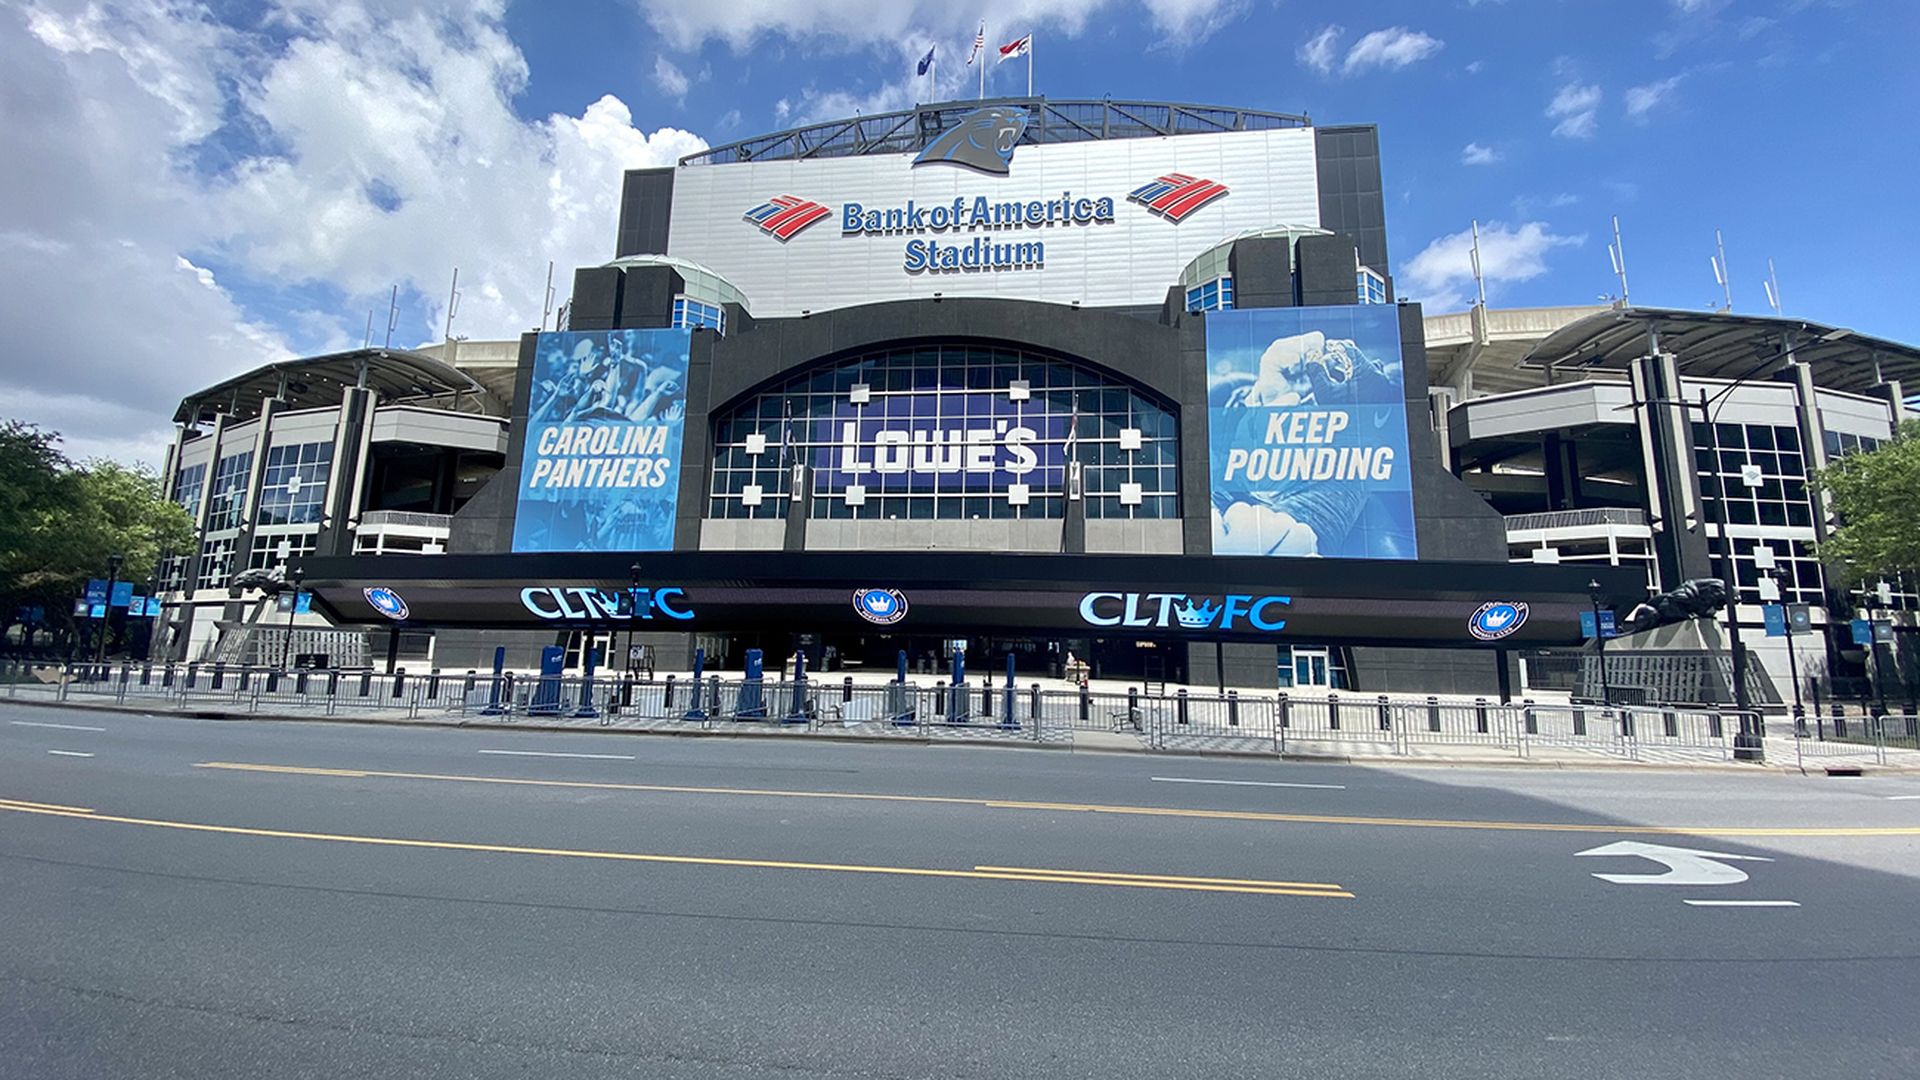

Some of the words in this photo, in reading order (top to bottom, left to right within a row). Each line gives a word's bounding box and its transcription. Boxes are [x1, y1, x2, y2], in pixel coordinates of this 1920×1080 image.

[842, 200, 925, 234] Bank
[929, 196, 965, 230] of
[969, 191, 1114, 227] America
[904, 236, 1045, 271] Stadium
[537, 425, 669, 456] CAROLINA
[1264, 411, 1349, 445] KEEP
[840, 419, 1038, 475] LOWE'S
[1223, 446, 1395, 481] POUNDING
[529, 458, 671, 488] PANTHERS
[520, 587, 603, 619] CLT
[1079, 591, 1187, 627] CLT
[1218, 594, 1291, 631] FC
